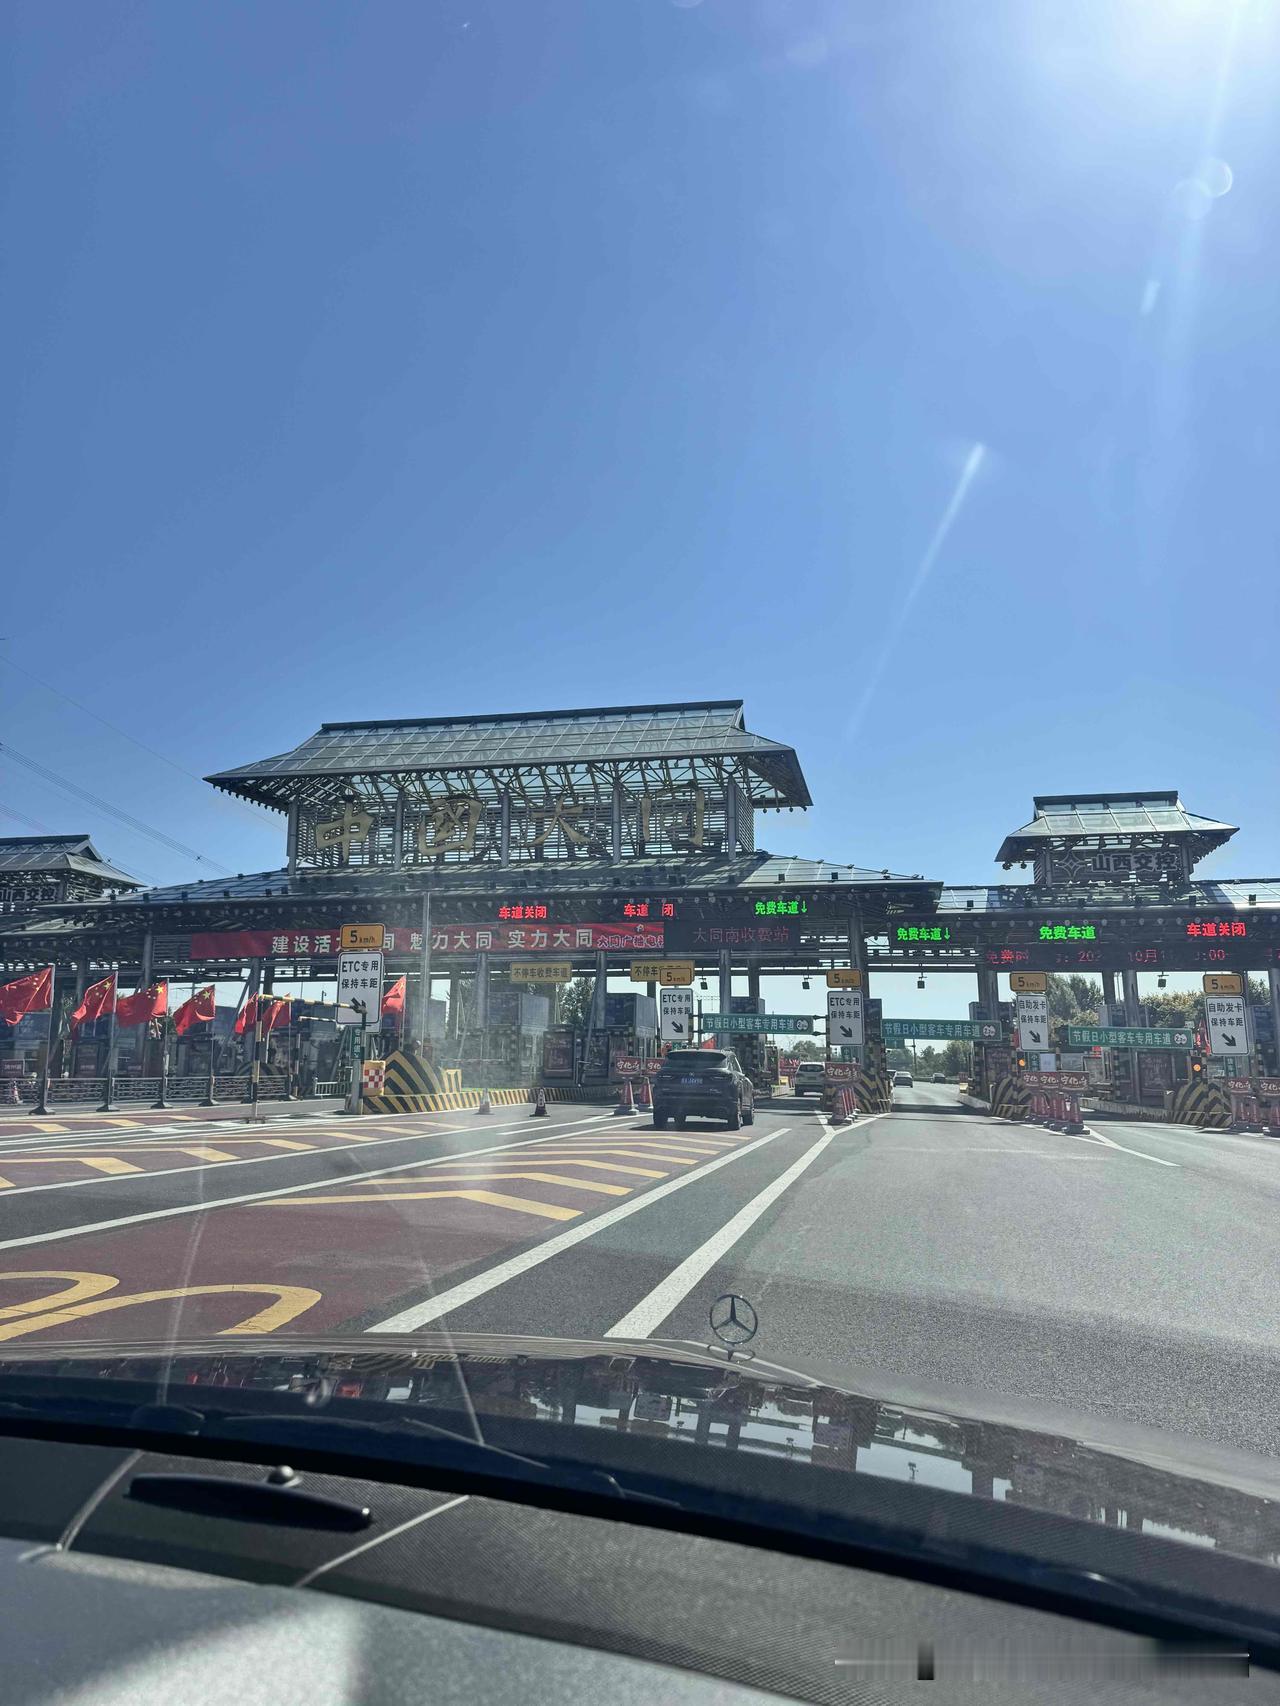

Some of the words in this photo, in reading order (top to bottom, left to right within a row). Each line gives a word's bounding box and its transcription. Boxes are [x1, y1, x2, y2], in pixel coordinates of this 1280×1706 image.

[1092, 852, 1177, 872] 山西交控
[499, 906, 547, 919] 车道关闭
[755, 901, 799, 915] 免费车道
[694, 926, 790, 944] 大同南收费站
[897, 927, 942, 941] 免费车道
[1039, 926, 1097, 940] 免费车道
[1187, 922, 1247, 937] 车道关闭
[272, 932, 395, 954] 建设活同
[508, 928, 593, 948] 实力大同
[342, 960, 379, 973] ETC专用
[514, 967, 568, 978] 不停车收费车道
[341, 978, 378, 989] 保持车距
[662, 994, 691, 1003] ETC专用
[829, 997, 860, 1007] ETC专用
[1019, 1000, 1046, 1010] 自助发卡
[663, 1006, 691, 1015] 保持车距
[1208, 1002, 1243, 1013] 自助发卡
[831, 1010, 860, 1020] 保持车距
[1020, 1014, 1047, 1024] 保持车距
[706, 1017, 794, 1030] 节假日小型客车专用车道
[1211, 1017, 1244, 1027] 保持车距
[884, 1023, 980, 1037] 节假日小型客车专用车道
[1072, 1031, 1172, 1045] 节假日小型客车专用车道
